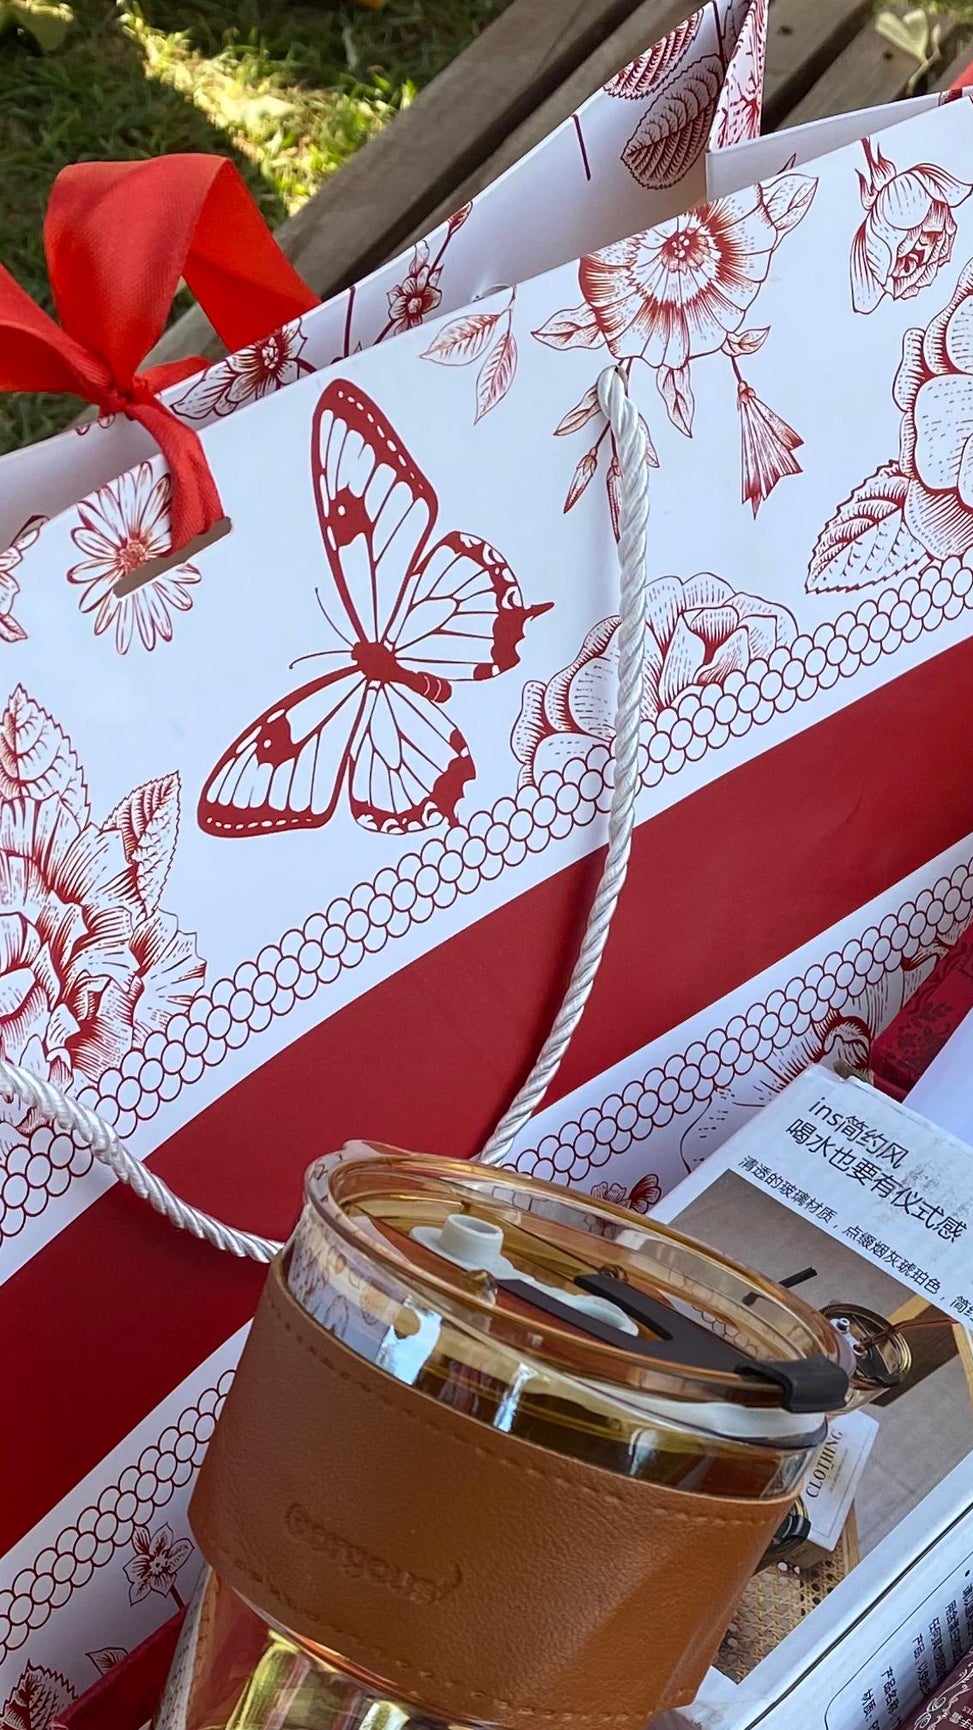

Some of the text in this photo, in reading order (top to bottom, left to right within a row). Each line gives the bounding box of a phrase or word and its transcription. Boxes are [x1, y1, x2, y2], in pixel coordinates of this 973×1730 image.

[808, 1097, 909, 1170] ins简约风
[785, 1117, 968, 1244] 喝水也要有仪式感
[805, 1429, 842, 1498] CLOTHING
